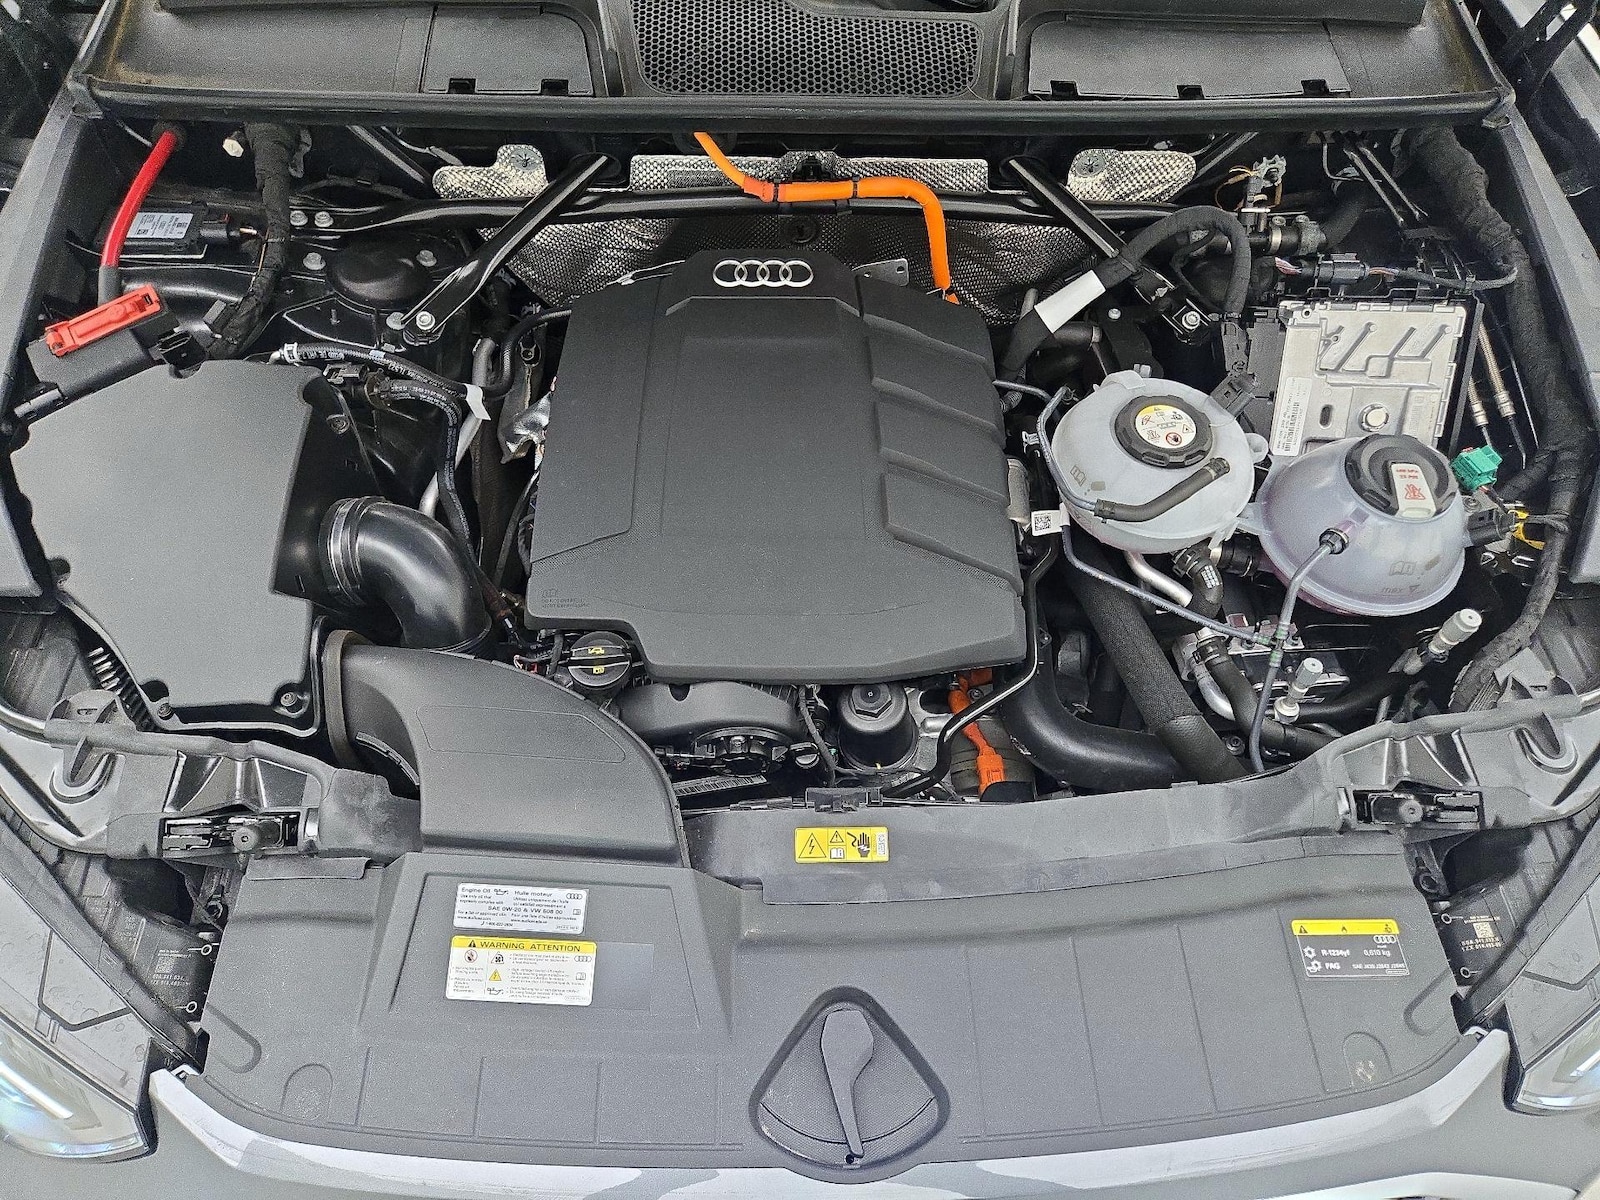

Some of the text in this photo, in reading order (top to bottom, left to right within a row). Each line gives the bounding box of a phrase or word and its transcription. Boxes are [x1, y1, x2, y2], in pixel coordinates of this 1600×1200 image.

[461, 886, 481, 894] Engine
[480, 941, 580, 952] WARNING ATTENTION
[1320, 949, 1350, 957] R-1234yf
[1382, 949, 1391, 958] kg
[1325, 962, 1341, 970] PAG
